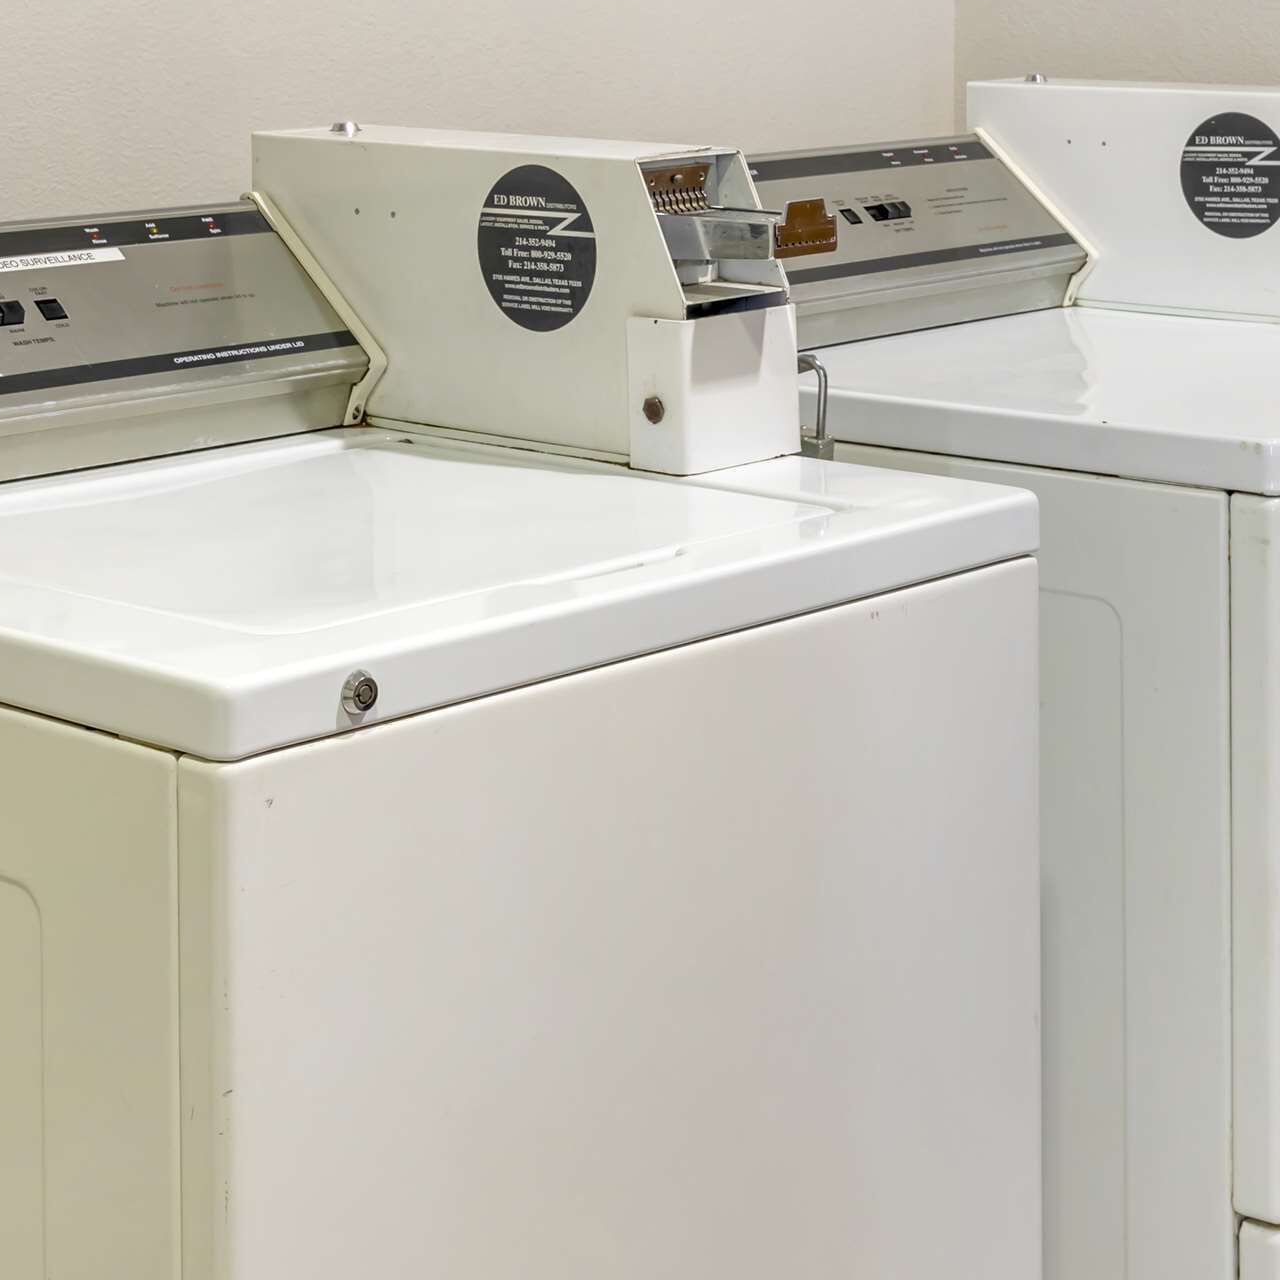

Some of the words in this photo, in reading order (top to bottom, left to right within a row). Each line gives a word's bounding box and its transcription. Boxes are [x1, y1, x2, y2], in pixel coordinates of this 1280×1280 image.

[1195, 136, 1208, 144] ED
[1210, 136, 1245, 144] BROWN
[494, 194, 508, 206] ED
[509, 195, 546, 208] BROWN
[515, 237, 556, 248] 214-352-9494
[500, 248, 513, 256] Toll
[514, 248, 530, 258] Free:
[20, 252, 96, 267] SURVEILLANCE
[508, 260, 522, 269] Fax:
[524, 261, 564, 272] 214-358-5873
[174, 352, 216, 364] OPERATING
[216, 347, 267, 358] INSTRUCTIONS
[267, 343, 292, 352] UNDER
